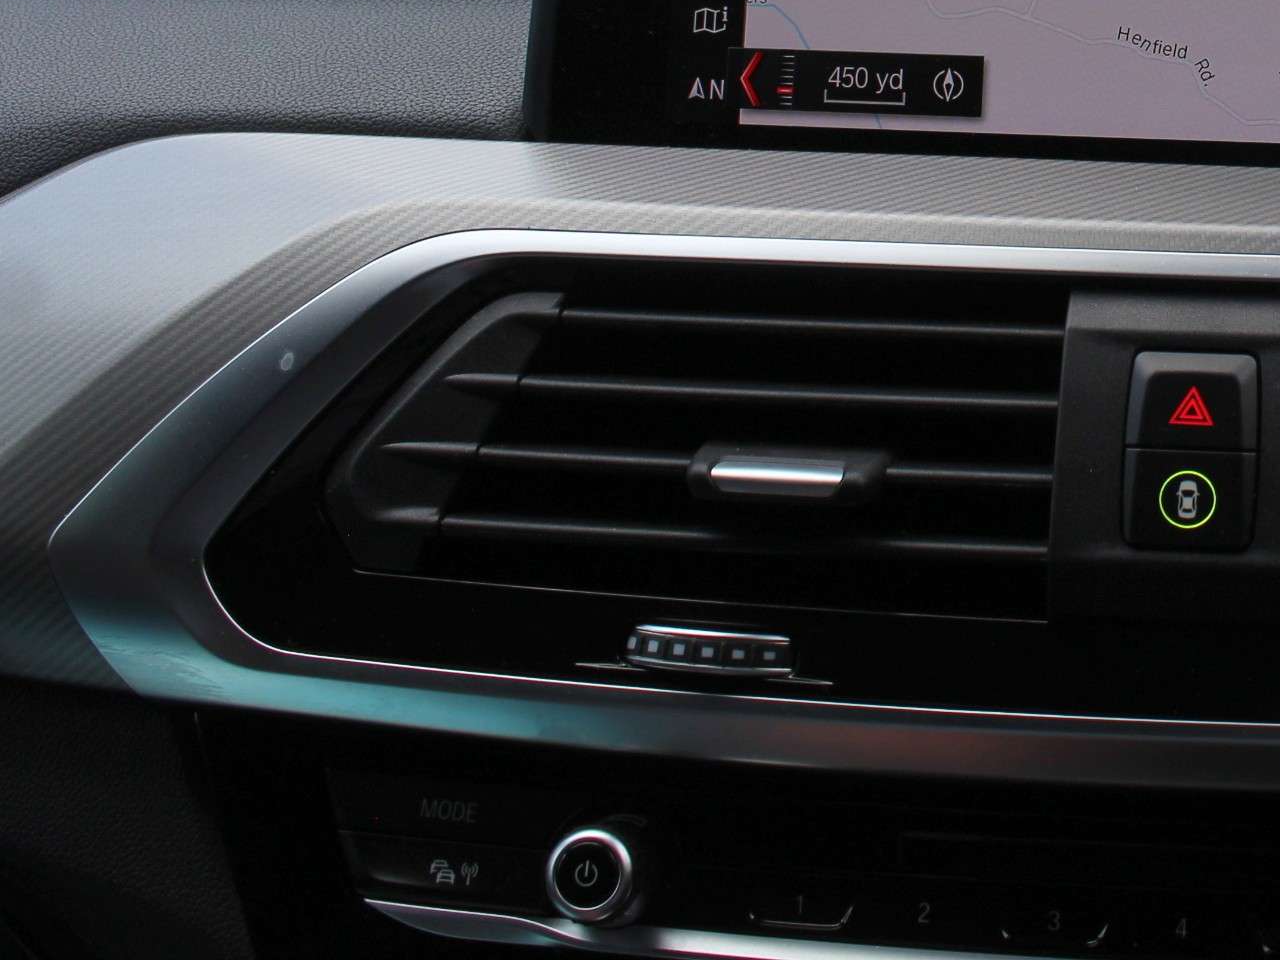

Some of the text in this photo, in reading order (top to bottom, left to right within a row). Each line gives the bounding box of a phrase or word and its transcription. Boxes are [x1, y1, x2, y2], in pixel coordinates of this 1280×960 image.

[1117, 26, 1215, 87] Henfield Rd.
[828, 66, 904, 94] 450 yd
[420, 797, 478, 824] MODE
[917, 902, 931, 923] 2
[1047, 910, 1061, 931] 3
[1175, 916, 1190, 939] 4
